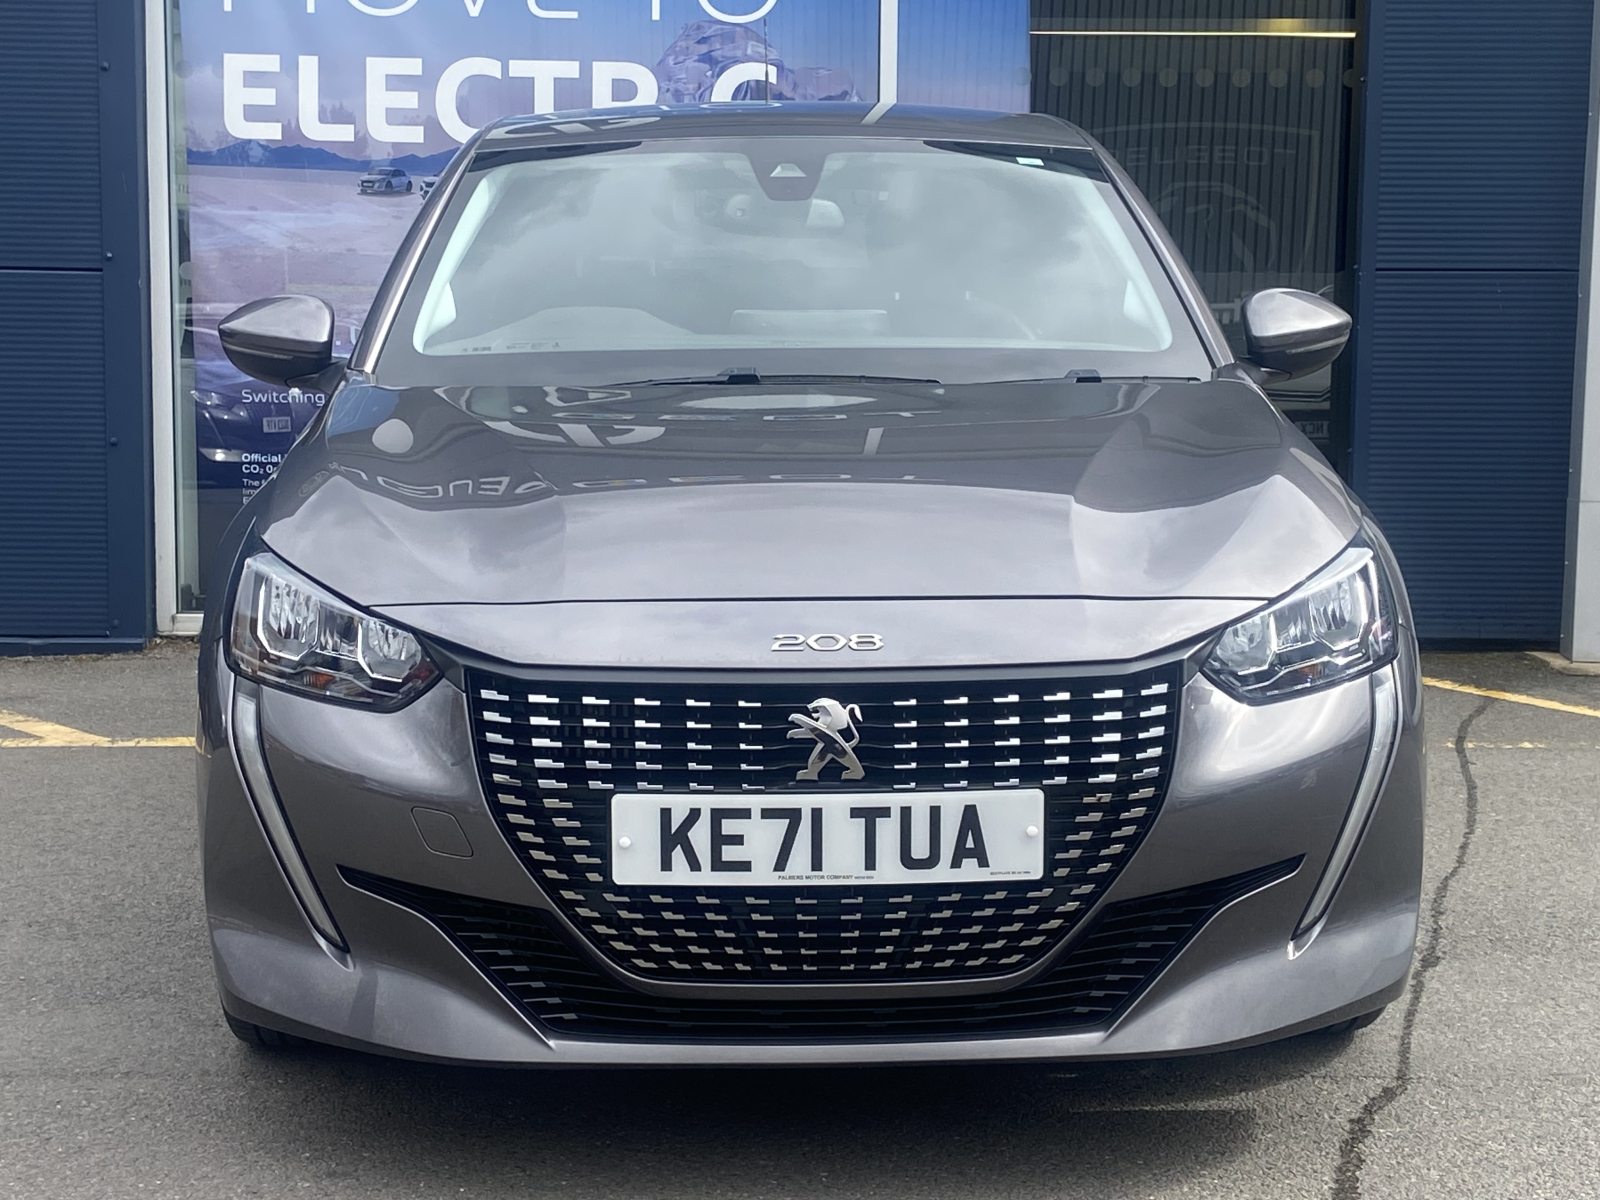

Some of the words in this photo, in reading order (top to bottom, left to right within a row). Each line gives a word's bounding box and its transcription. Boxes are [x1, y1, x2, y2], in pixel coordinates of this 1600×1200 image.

[241, 388, 325, 407] Switching
[241, 453, 282, 462] Official
[241, 478, 260, 487] The
[770, 633, 885, 652] 208
[659, 807, 823, 872] KE71
[850, 804, 991, 871] TUA
